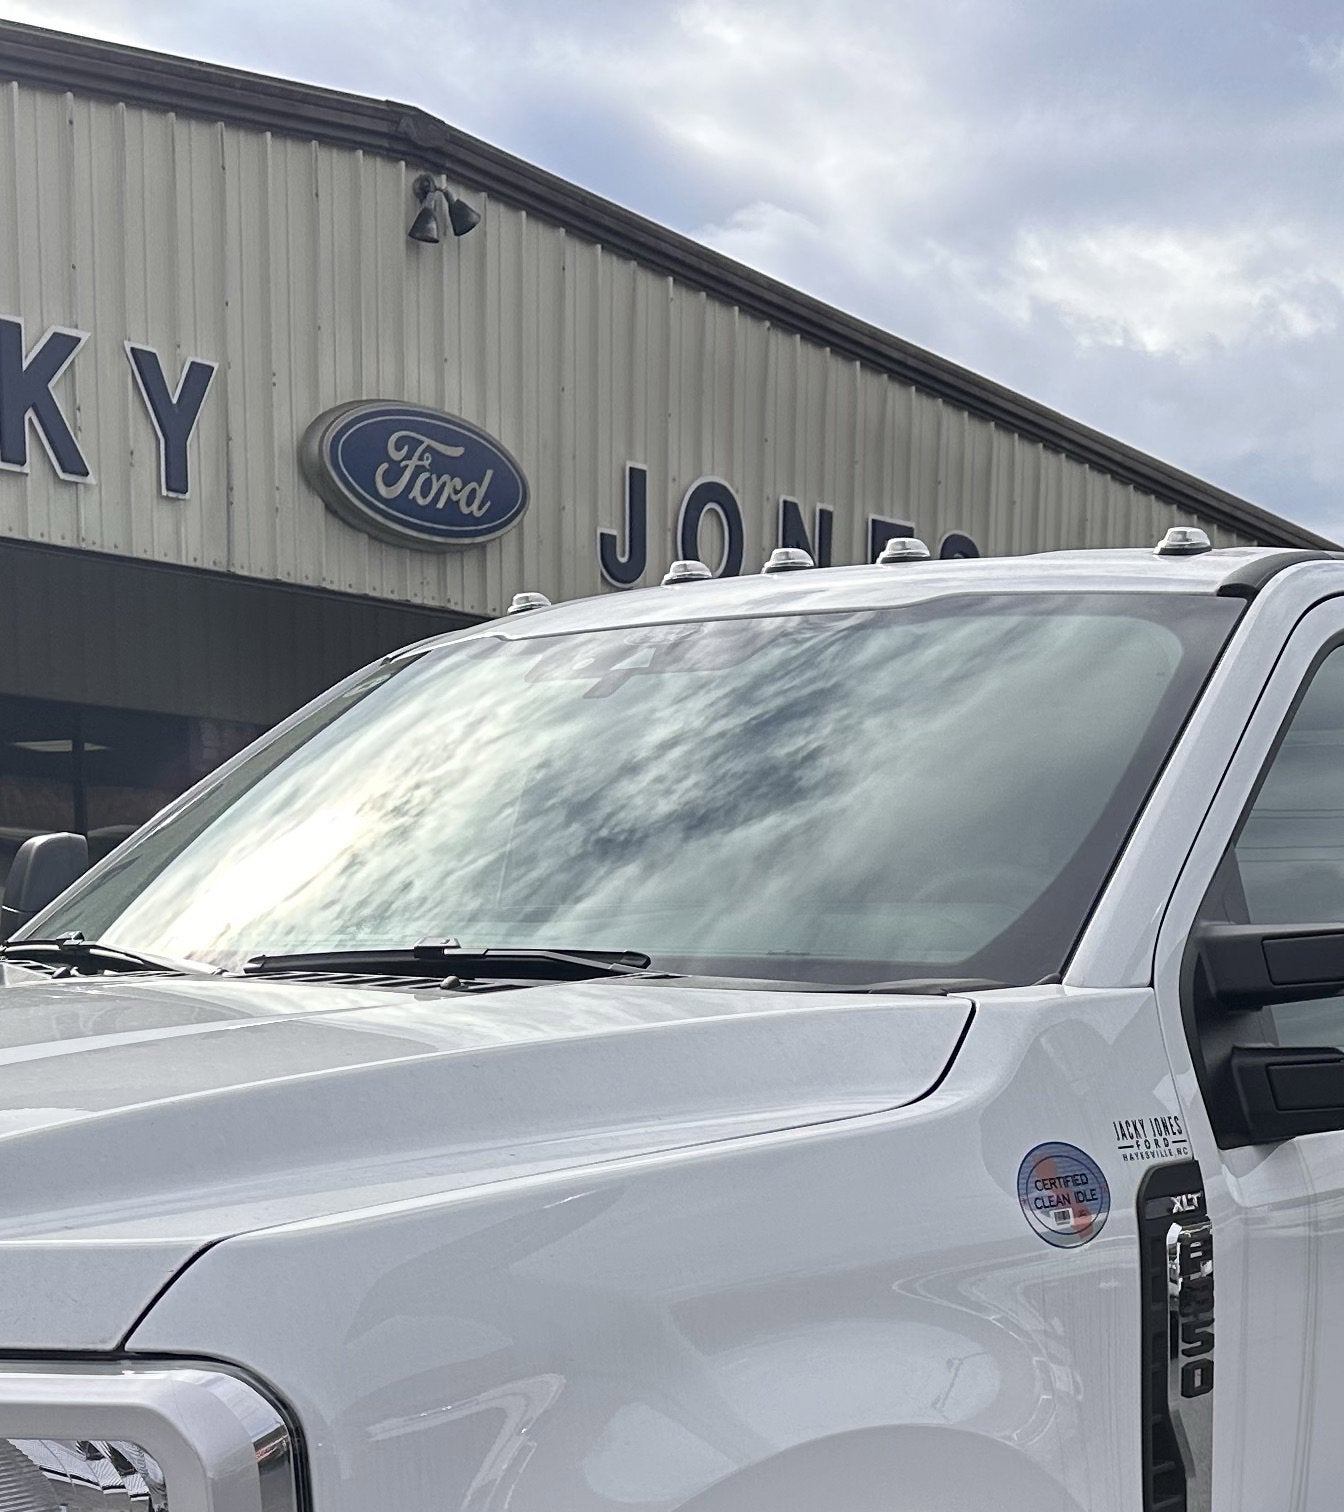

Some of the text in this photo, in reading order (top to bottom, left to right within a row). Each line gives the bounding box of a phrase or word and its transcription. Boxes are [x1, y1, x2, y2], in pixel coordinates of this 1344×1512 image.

[375, 430, 494, 518] Ford
[1112, 1115, 1182, 1141] JACKY JONES
[1136, 1138, 1169, 1150] FORD
[1034, 1173, 1089, 1192] CERTIFIED
[1033, 1188, 1099, 1210] CLEAN IDLE
[1168, 1191, 1202, 1214] XLT
